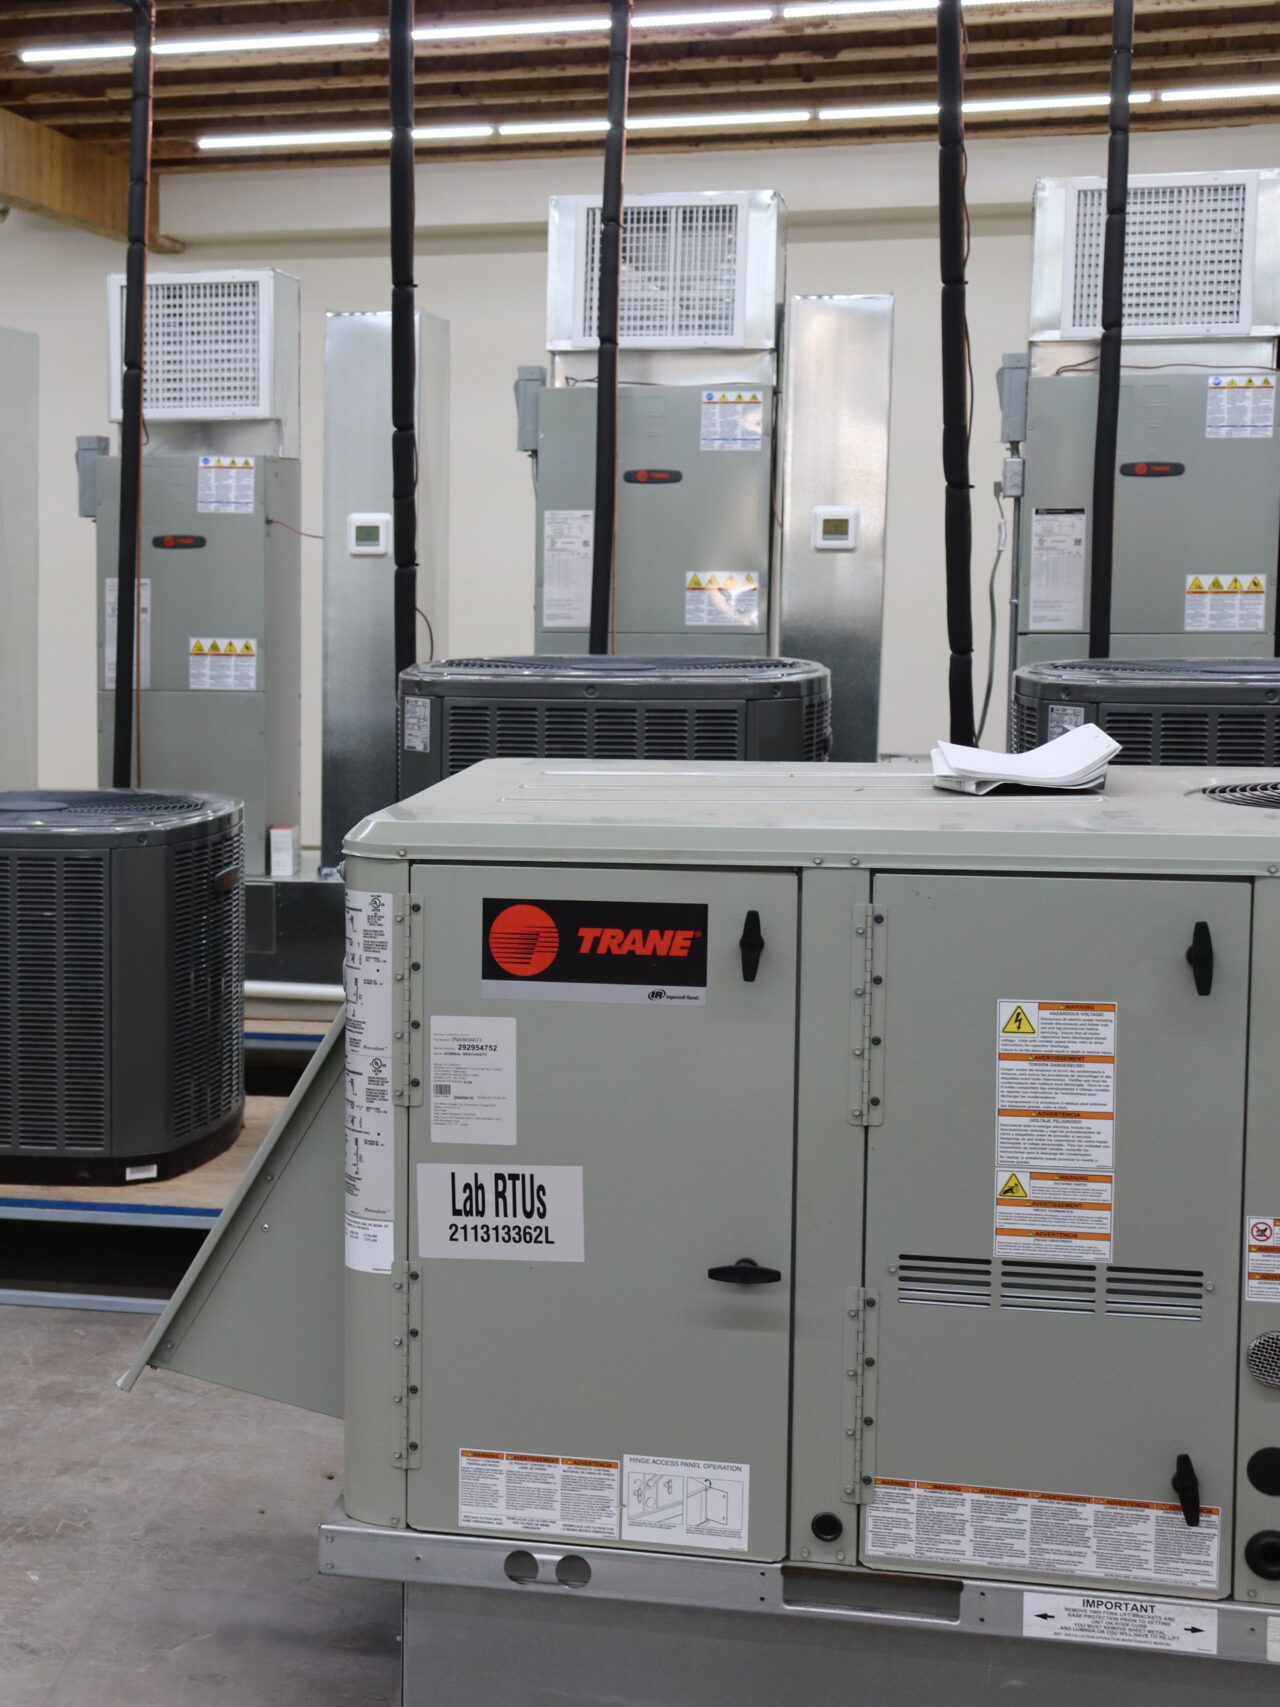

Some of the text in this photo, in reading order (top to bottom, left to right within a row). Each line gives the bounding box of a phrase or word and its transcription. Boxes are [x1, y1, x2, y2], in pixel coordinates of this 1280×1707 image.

[578, 928, 694, 956] TRANE
[458, 1044, 498, 1052] 292954752
[451, 1172, 547, 1220] Lab RTUs
[449, 1223, 555, 1244] 211313362L
[652, 1459, 679, 1467] ACCESS
[681, 1461, 701, 1469] PANEL
[703, 1463, 742, 1472] OPERATION
[1083, 1599, 1156, 1613] IMPORTANT
